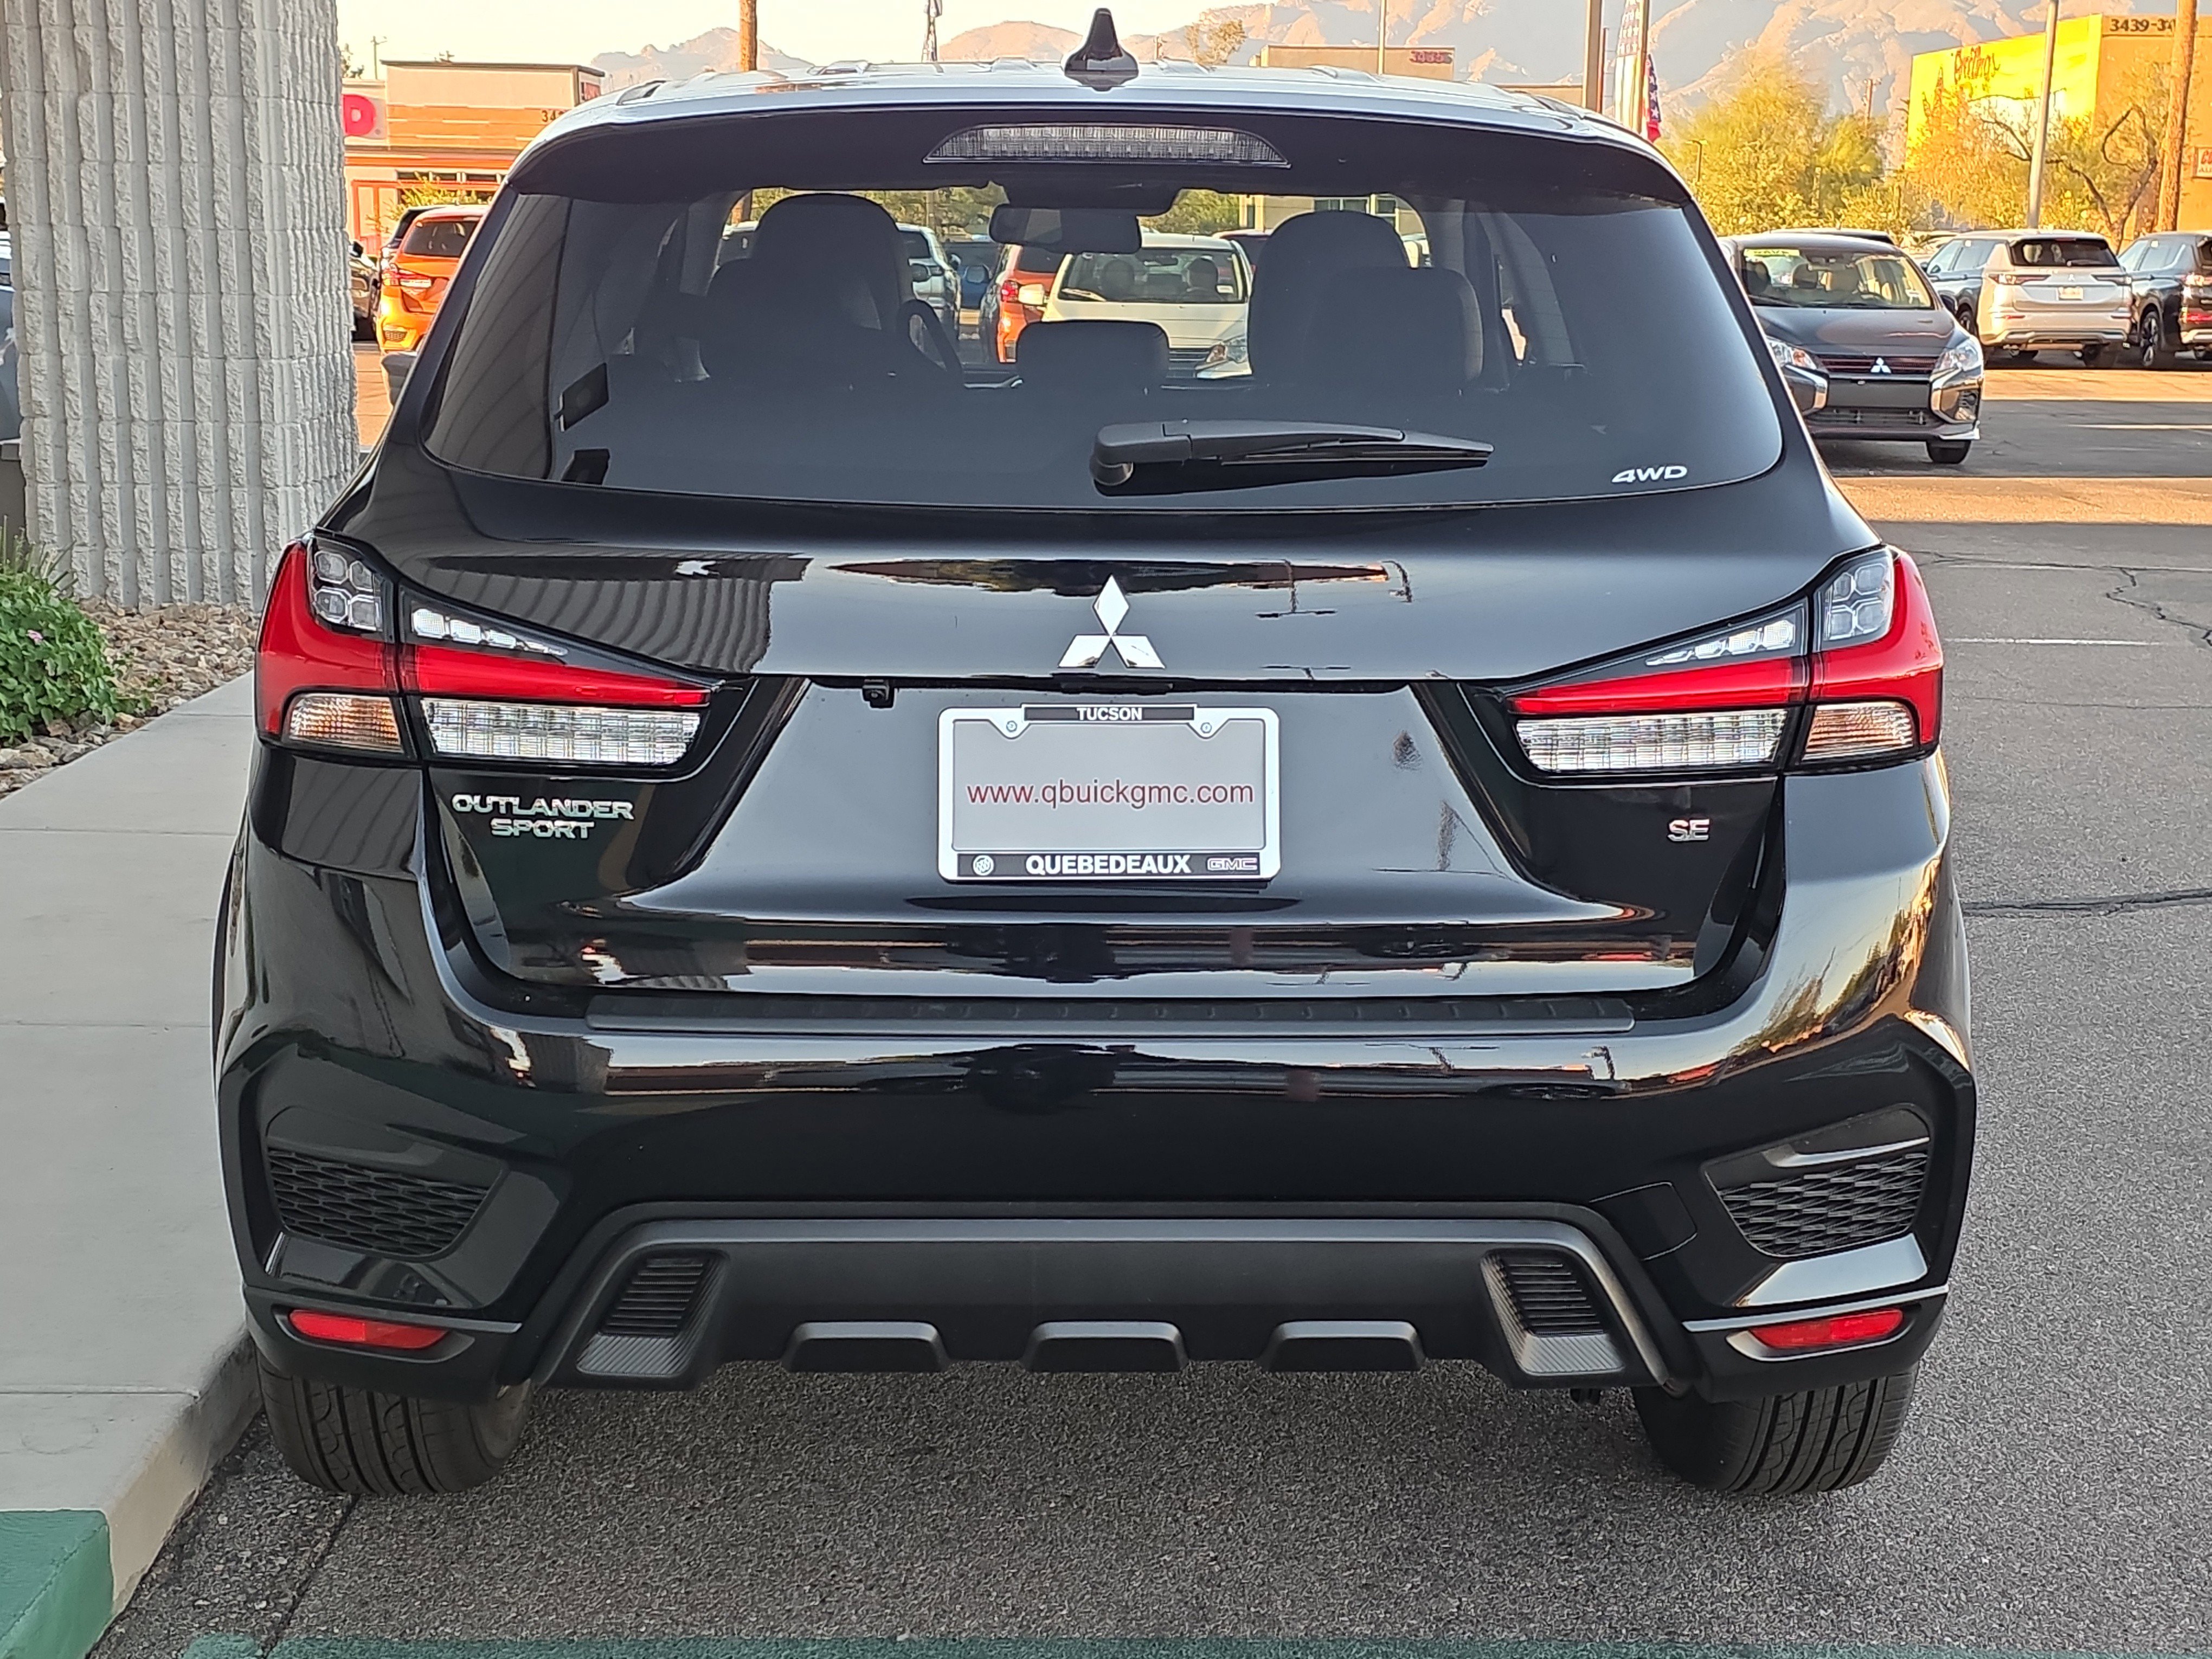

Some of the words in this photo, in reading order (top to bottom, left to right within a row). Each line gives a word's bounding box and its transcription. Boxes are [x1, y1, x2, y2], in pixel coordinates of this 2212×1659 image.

[542, 110, 564, 122] 34
[1611, 465, 1688, 484] 4WD
[1076, 707, 1143, 721] TUCSON
[967, 779, 1254, 809] www.qbuickgmc.com
[452, 794, 634, 820] OUTLANDER
[490, 818, 595, 839] SPORT
[1667, 819, 1710, 842] SE
[1026, 855, 1191, 875] QUEBEDEAUX
[1207, 857, 1258, 872] GMC
